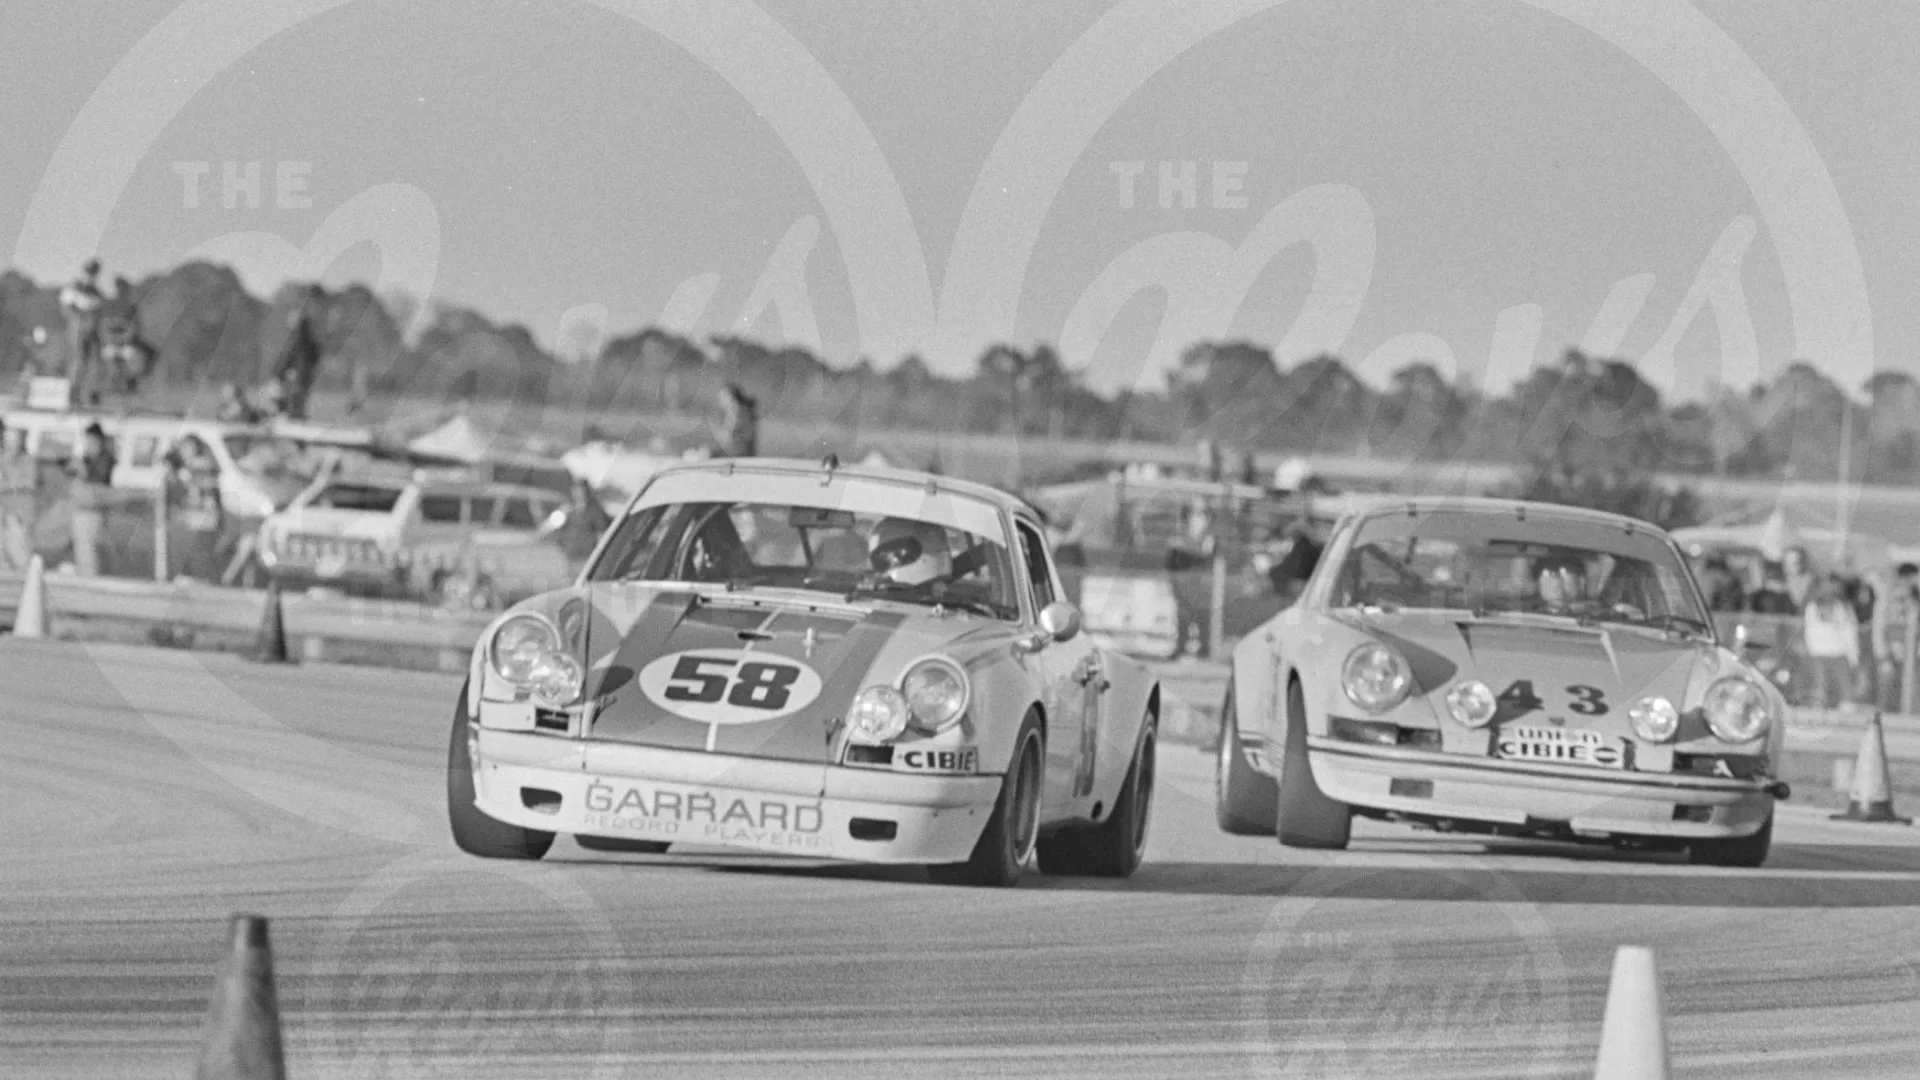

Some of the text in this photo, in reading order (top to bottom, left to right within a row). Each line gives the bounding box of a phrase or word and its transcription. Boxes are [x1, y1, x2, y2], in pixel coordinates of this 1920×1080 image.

[664, 653, 801, 711] 58
[904, 751, 974, 771] CIBIE
[1499, 741, 1589, 759] CIBIE
[584, 783, 823, 834] GARRARD
[584, 813, 680, 835] RECORD
